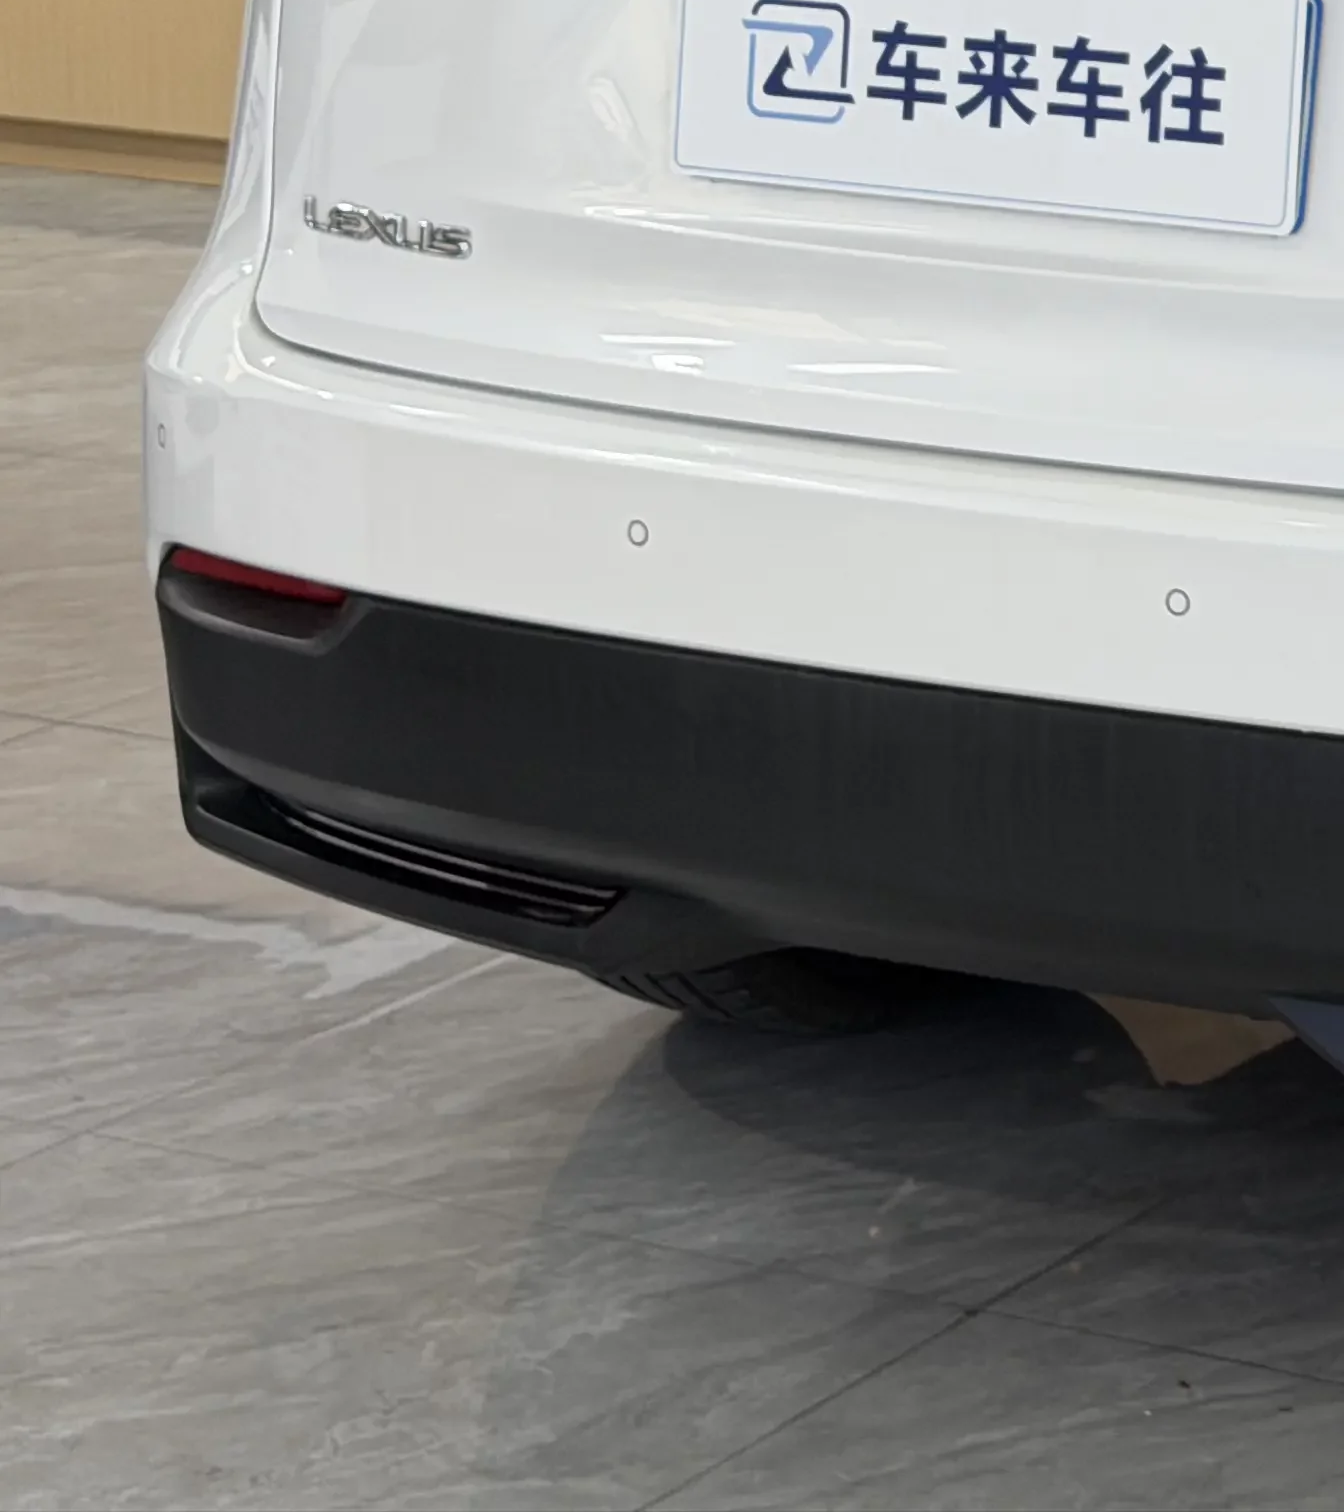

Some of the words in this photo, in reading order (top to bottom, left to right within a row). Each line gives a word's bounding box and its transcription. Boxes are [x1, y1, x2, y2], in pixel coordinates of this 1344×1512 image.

[866, 20, 1227, 146] 车来车往
[303, 194, 473, 260] LEXUS
